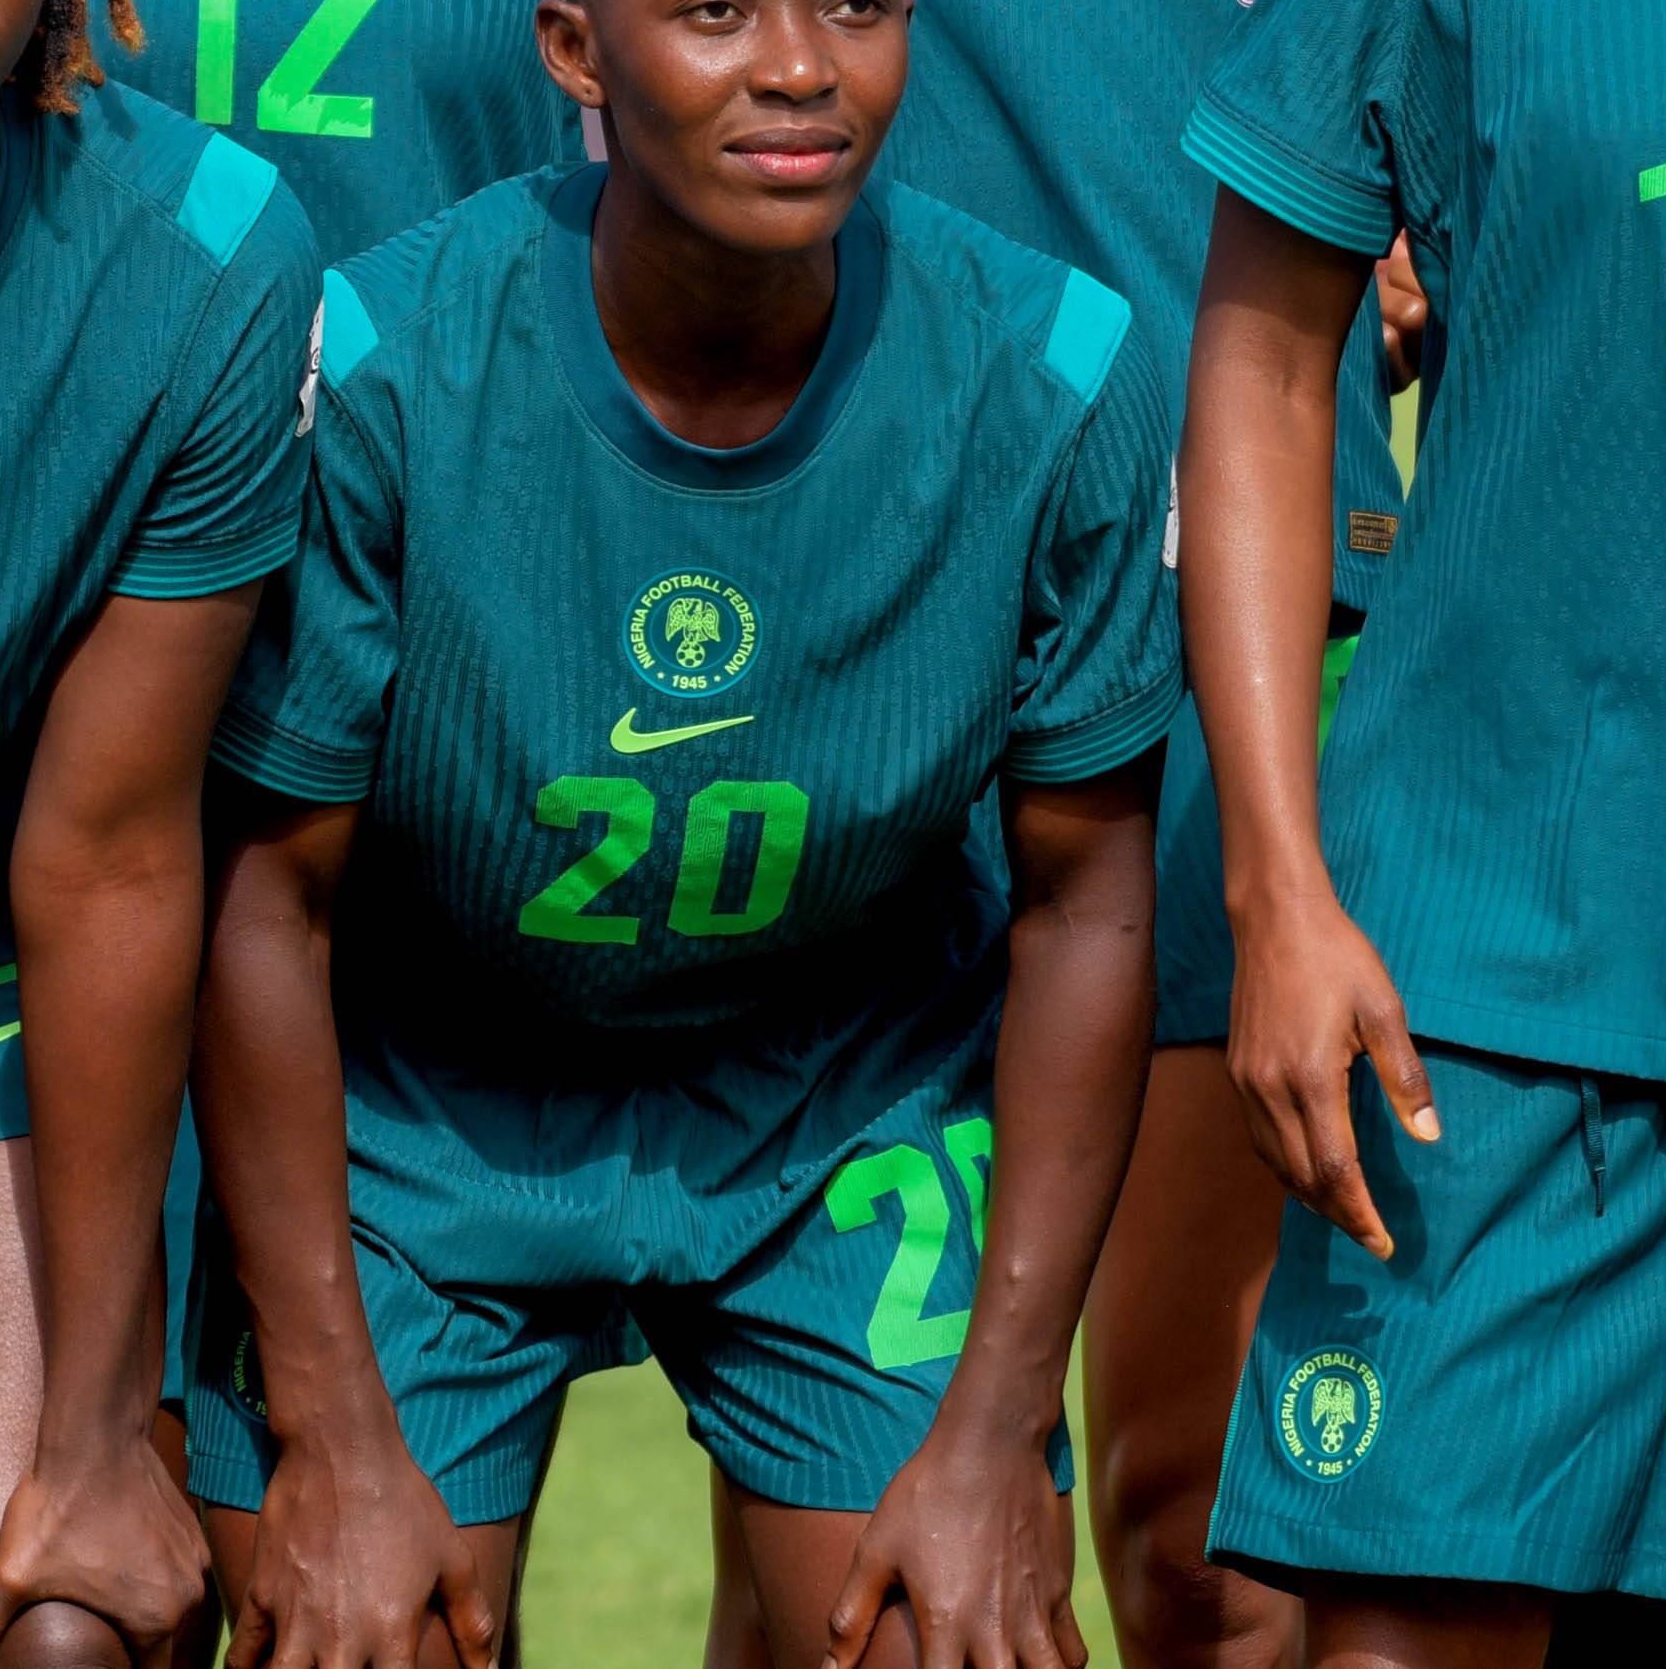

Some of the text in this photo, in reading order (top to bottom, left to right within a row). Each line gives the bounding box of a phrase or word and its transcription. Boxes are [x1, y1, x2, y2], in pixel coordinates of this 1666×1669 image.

[631, 575, 755, 675] NIGERIA FOOTBALL FEDERATION
[672, 675, 708, 689] 1945
[518, 775, 810, 946] 20
[1282, 1353, 1381, 1457] NIGERIA FOOTBALL FEDERATION
[1318, 1461, 1343, 1475] 1945
